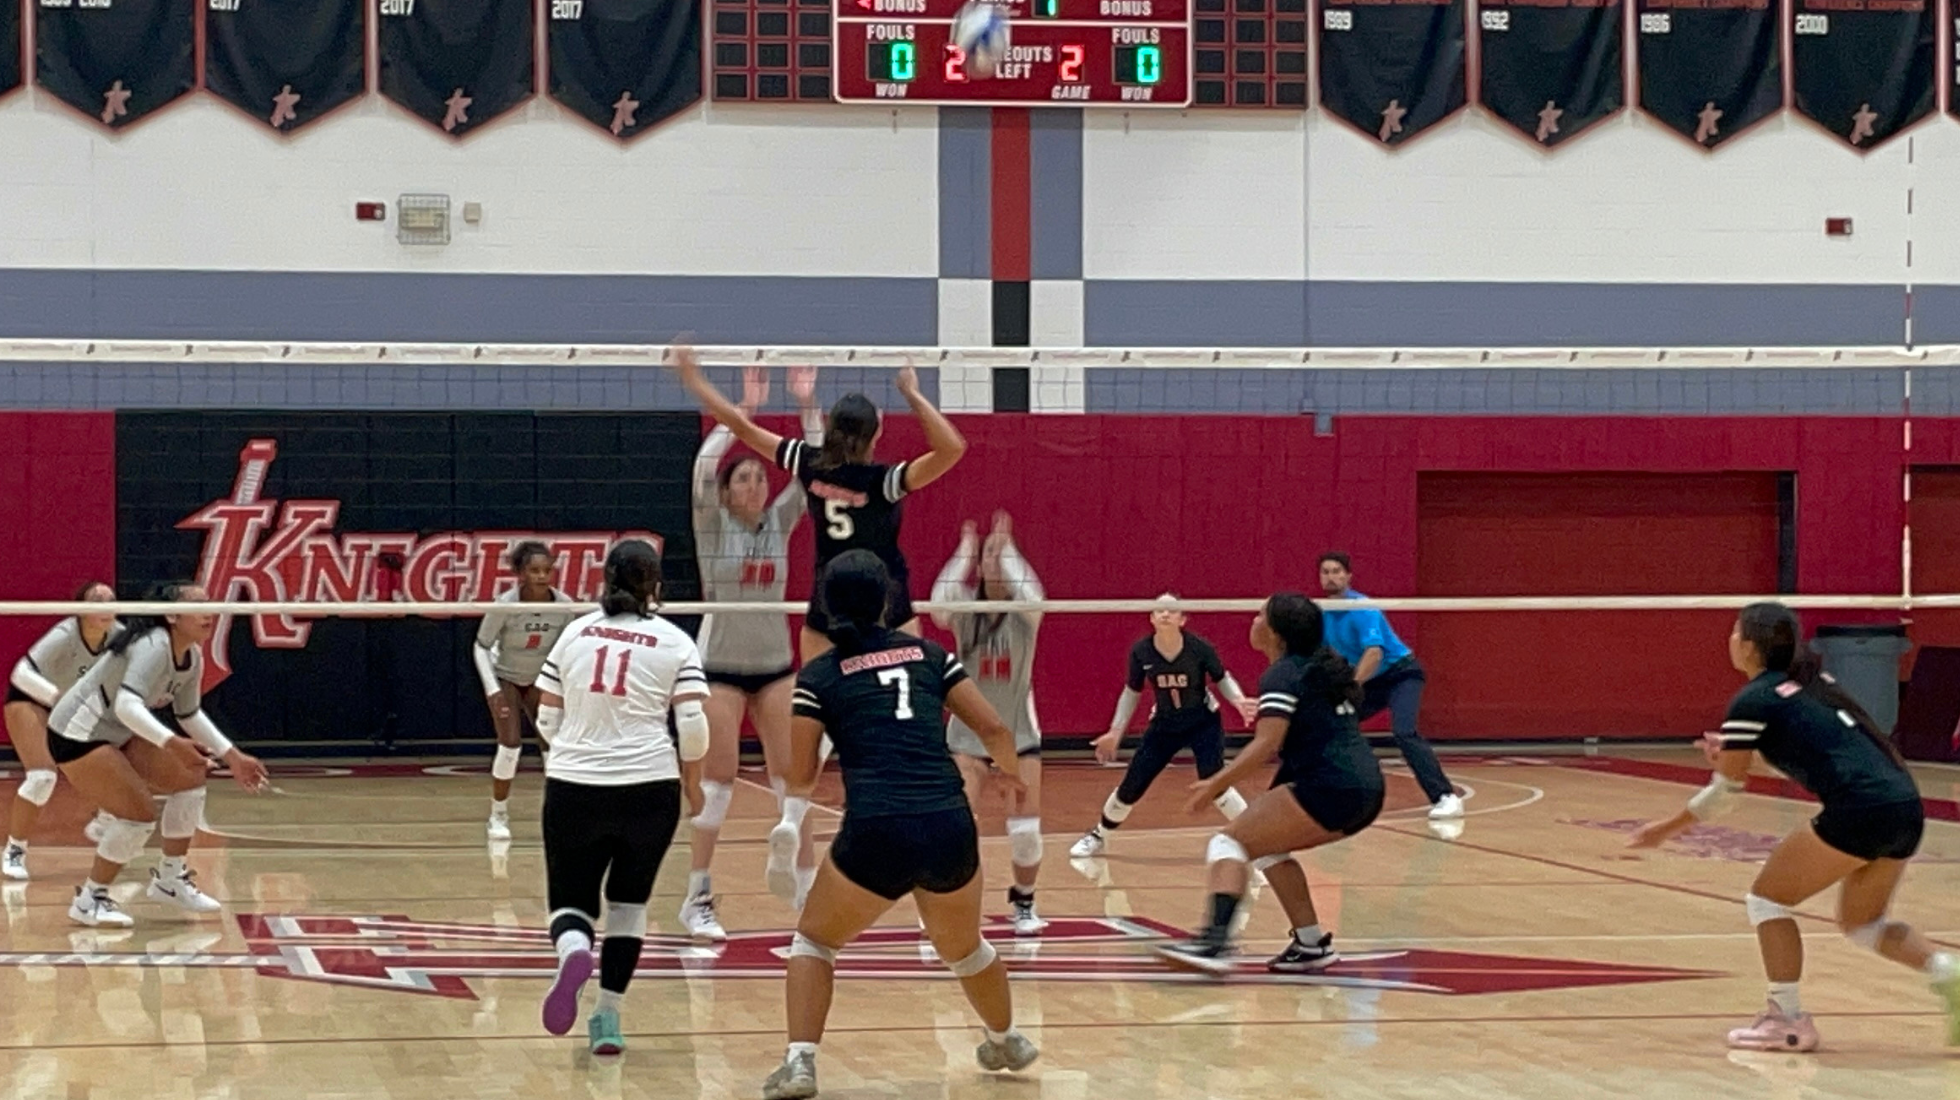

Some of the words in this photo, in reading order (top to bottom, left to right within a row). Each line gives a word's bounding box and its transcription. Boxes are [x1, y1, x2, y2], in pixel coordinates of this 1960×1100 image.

[379, 0, 413, 15] 2017
[551, 0, 582, 19] 2017
[873, 0, 926, 12] BONUS
[1100, 0, 1152, 16] BONUS
[866, 24, 915, 40] FOULS
[1111, 28, 1160, 44] FOULS
[891, 42, 915, 80] 0
[945, 44, 967, 81] 2
[998, 45, 1053, 63] EOUTS
[995, 63, 1032, 80] LEFT
[1060, 44, 1084, 82] 2
[1136, 46, 1160, 83] 0
[875, 83, 908, 98] WON
[1050, 85, 1092, 100] GAME
[1120, 86, 1152, 101] WON
[824, 499, 855, 541] 5
[589, 644, 632, 698] 11
[1156, 673, 1189, 689] SAC
[876, 667, 914, 721] 7
[1170, 688, 1182, 710] 1
